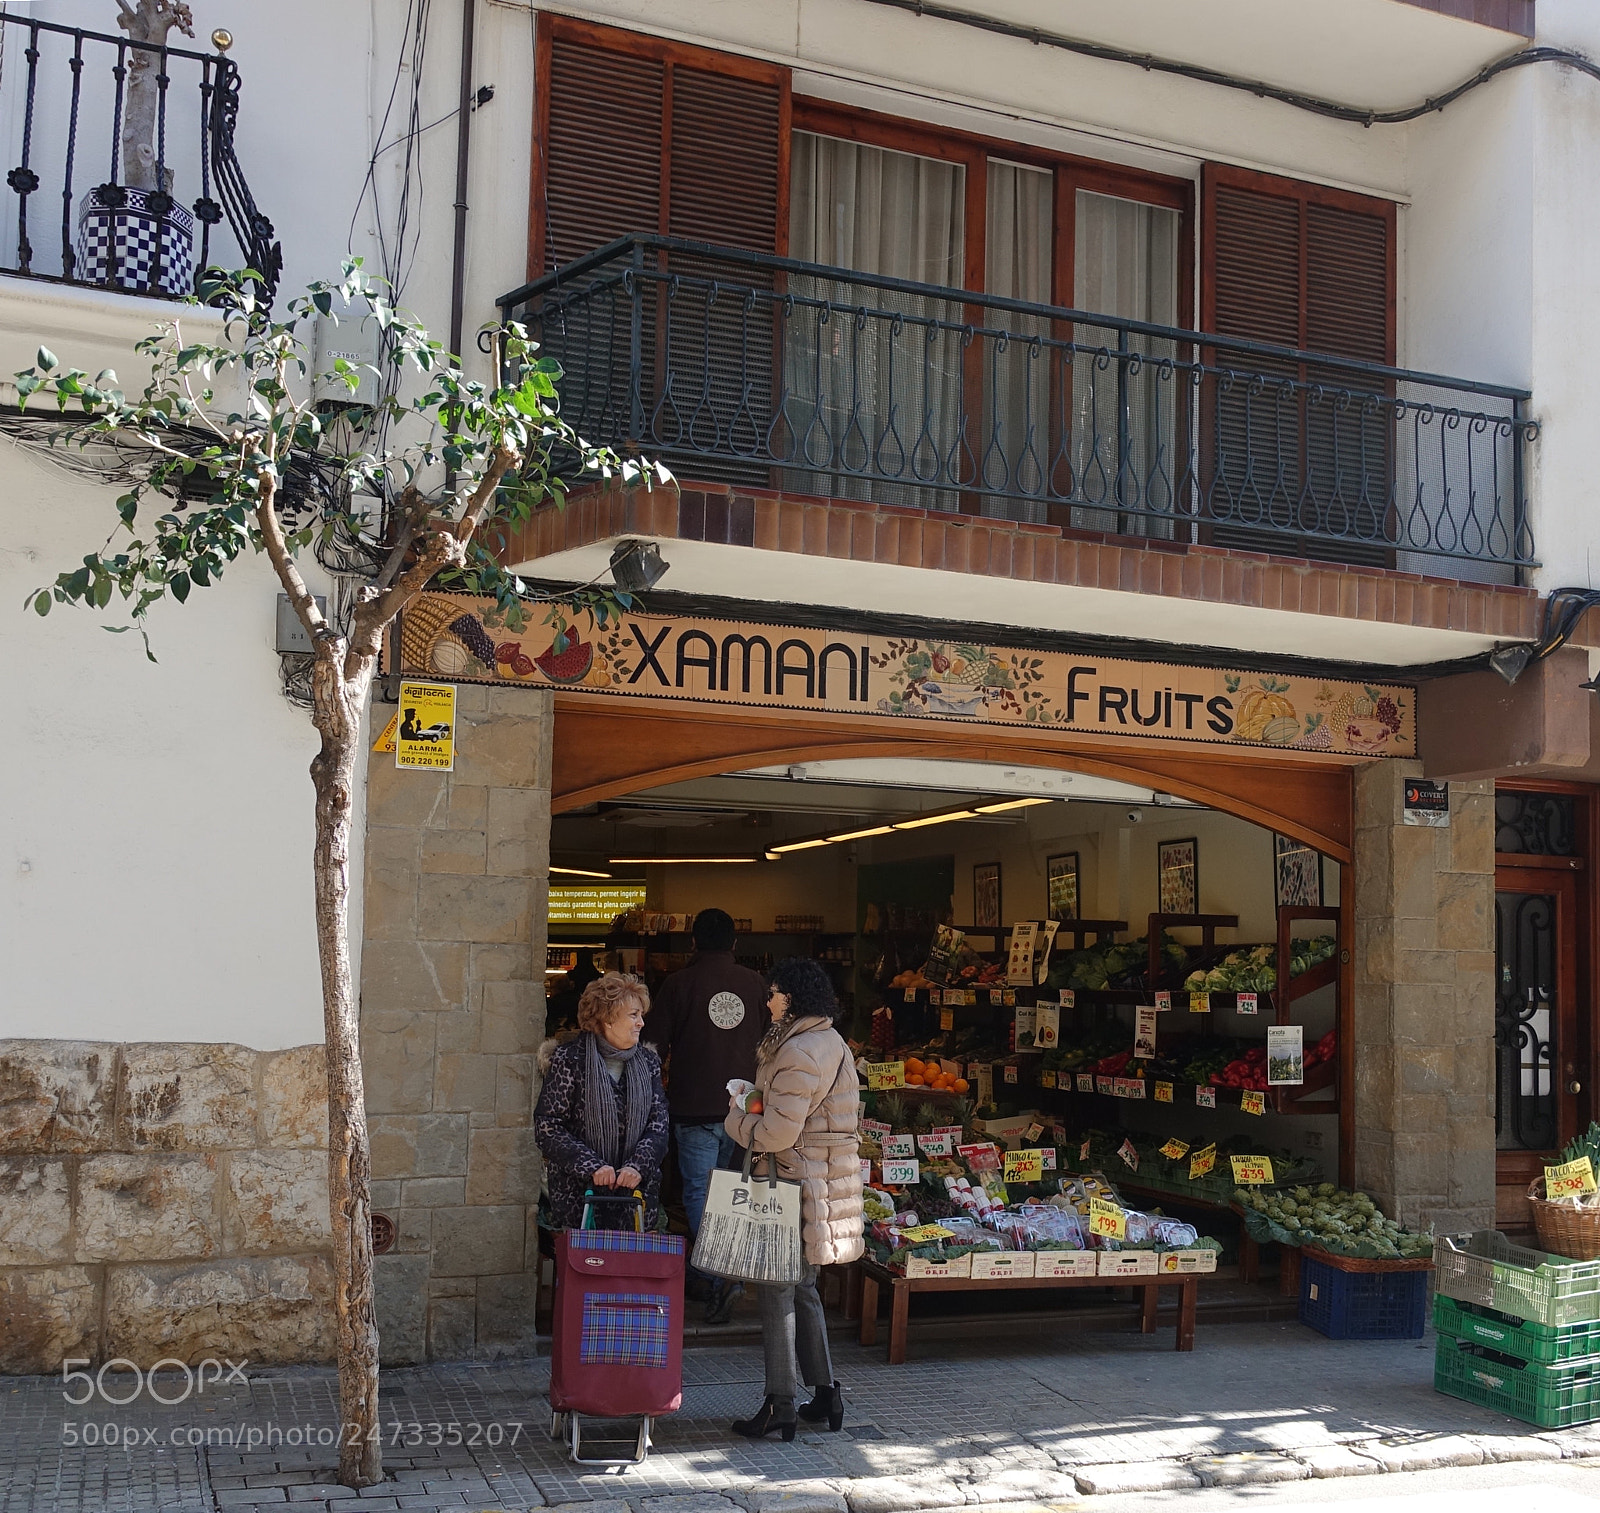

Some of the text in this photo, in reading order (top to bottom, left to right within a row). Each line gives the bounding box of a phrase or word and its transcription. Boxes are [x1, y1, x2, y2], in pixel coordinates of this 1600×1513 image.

[627, 623, 870, 702] XAMANI
[408, 744, 443, 752] ALARMA
[401, 756, 416, 764] 902
[1420, 791, 1446, 799] COVERT
[620, 890, 638, 898] ingerir
[572, 901, 596, 909] garantint
[604, 901, 619, 909] plena
[711, 994, 741, 1014] AMETLLER
[714, 1012, 742, 1026] ORIGEN
[1553, 1176, 1584, 1193] 3'98
